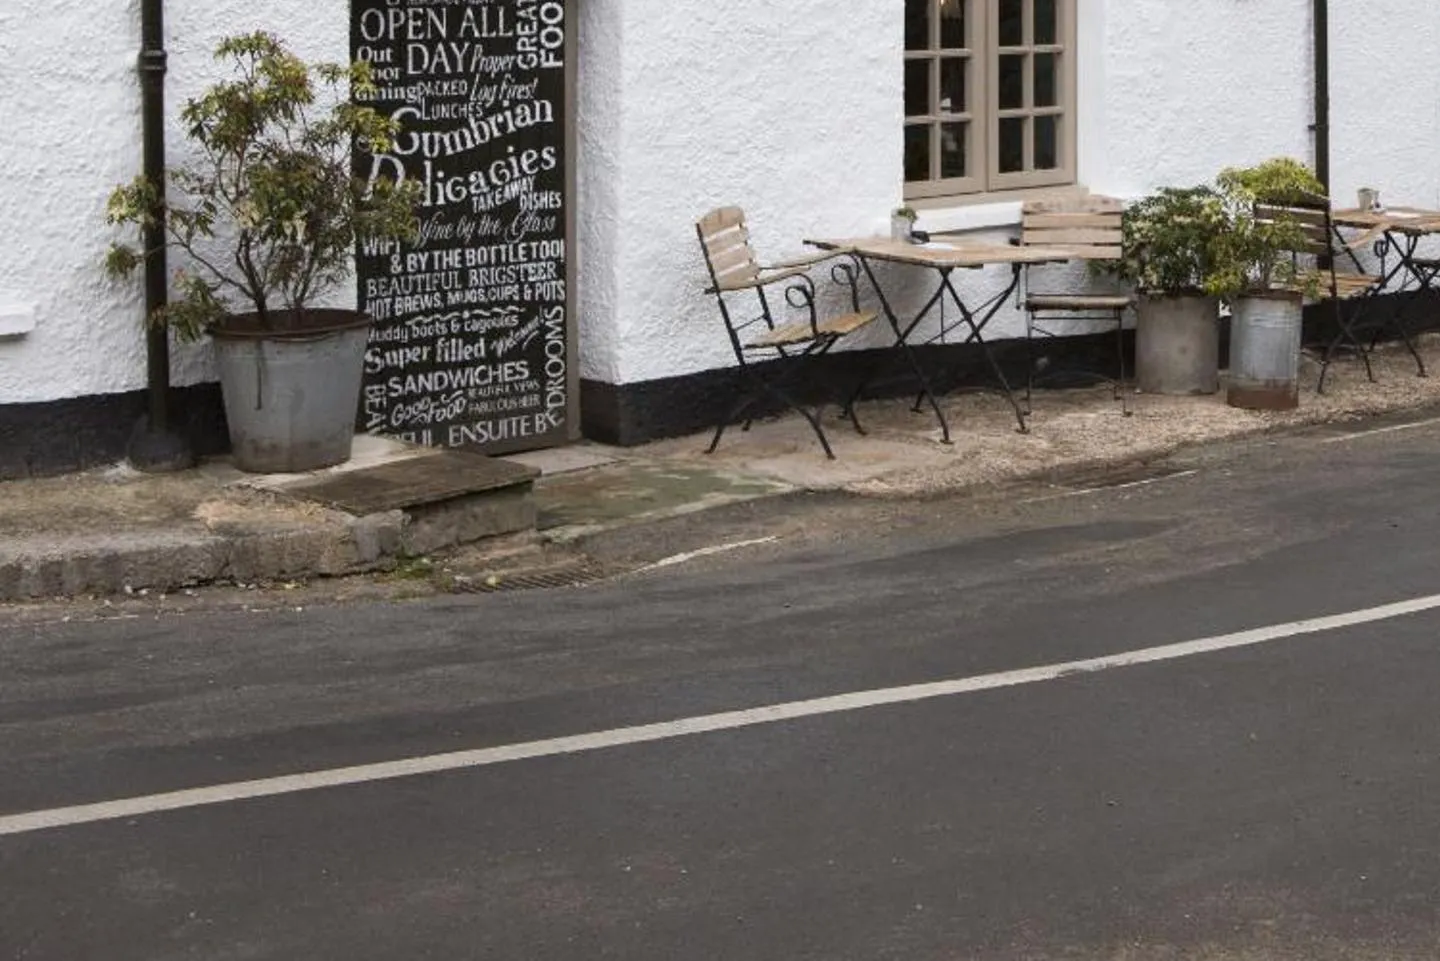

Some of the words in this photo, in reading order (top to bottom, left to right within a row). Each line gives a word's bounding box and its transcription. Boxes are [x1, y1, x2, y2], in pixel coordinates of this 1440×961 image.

[361, 7, 447, 41] OPEN
[458, 6, 513, 38] ALL
[357, 46, 394, 62] Out
[407, 42, 471, 74] DAY
[416, 79, 468, 105] PACKED
[389, 100, 554, 158] Cumbrian
[361, 145, 557, 207] Dlicacies
[472, 175, 536, 213] TAKEAWAY
[520, 190, 562, 210] DISHES
[391, 253, 402, 274] &
[407, 251, 430, 272] BY
[433, 247, 462, 271] THE
[465, 242, 529, 268] BOTTLE
[530, 238, 565, 263] TOO!
[366, 271, 462, 299] BEAUTIFUL
[469, 261, 558, 288] BRIGSTEER
[523, 283, 533, 301] &
[535, 279, 565, 301] POTS
[411, 320, 449, 339] boots
[364, 346, 432, 374] Super
[436, 337, 487, 362] filled
[388, 360, 530, 398] SANDWICHES
[449, 415, 533, 448] ENSUITE
[535, 305, 566, 435] BEDROOMS
